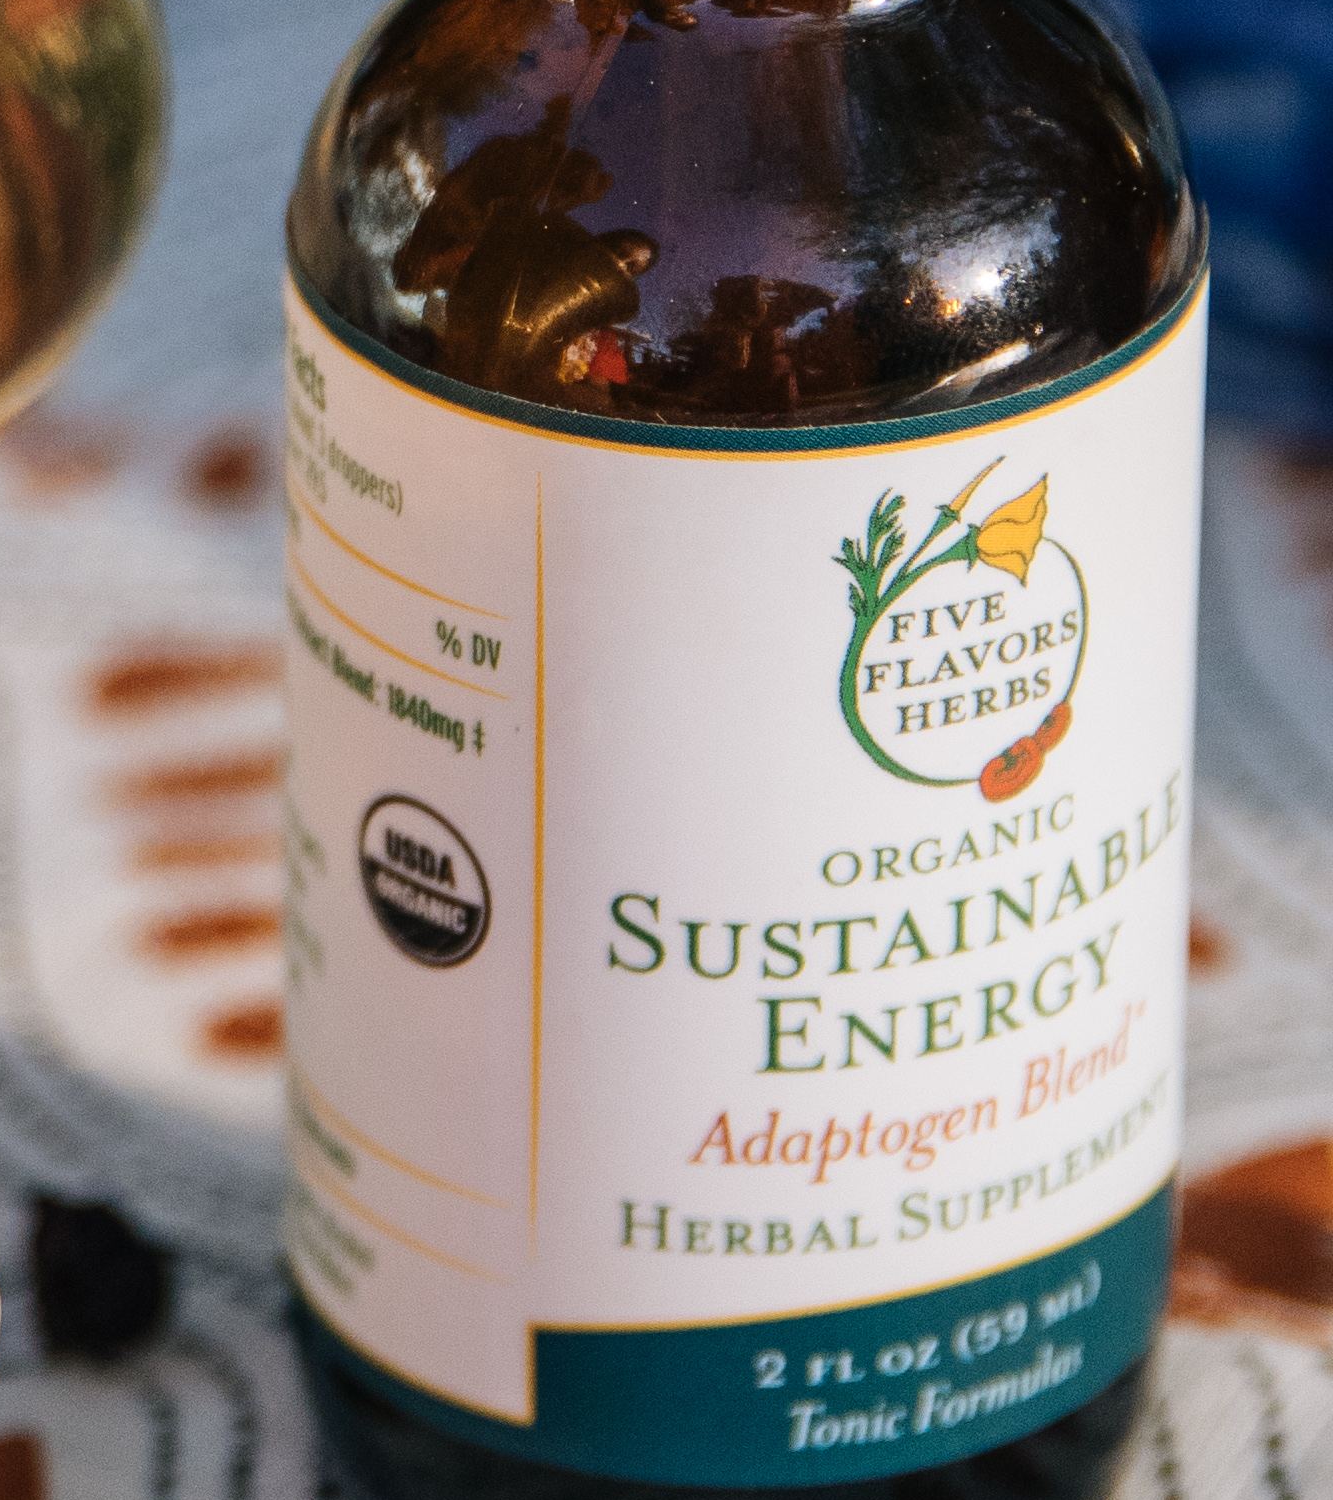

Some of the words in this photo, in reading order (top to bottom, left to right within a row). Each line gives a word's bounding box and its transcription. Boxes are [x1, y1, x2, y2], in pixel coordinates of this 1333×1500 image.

[435, 619, 464, 660] %
[472, 632, 501, 671] DV
[863, 610, 1078, 693] FLAVORS
[888, 592, 1006, 643] FIVE
[387, 682, 465, 754] 1840mg
[896, 667, 1052, 735] HERBS
[385, 827, 457, 890] USDA
[608, 768, 1183, 980] SUSTAINABLE
[822, 793, 1075, 887] ORGANIC
[376, 870, 467, 935] ORGANIC
[756, 920, 1123, 1074] ENERGY
[688, 1096, 999, 1185] Adaptogen
[619, 1199, 878, 1256] HERBAL
[752, 1349, 787, 1389] 2
[951, 1301, 1029, 1364] (59
[788, 1398, 907, 1451] Tonic
[912, 1340, 1083, 1435] Formulas
